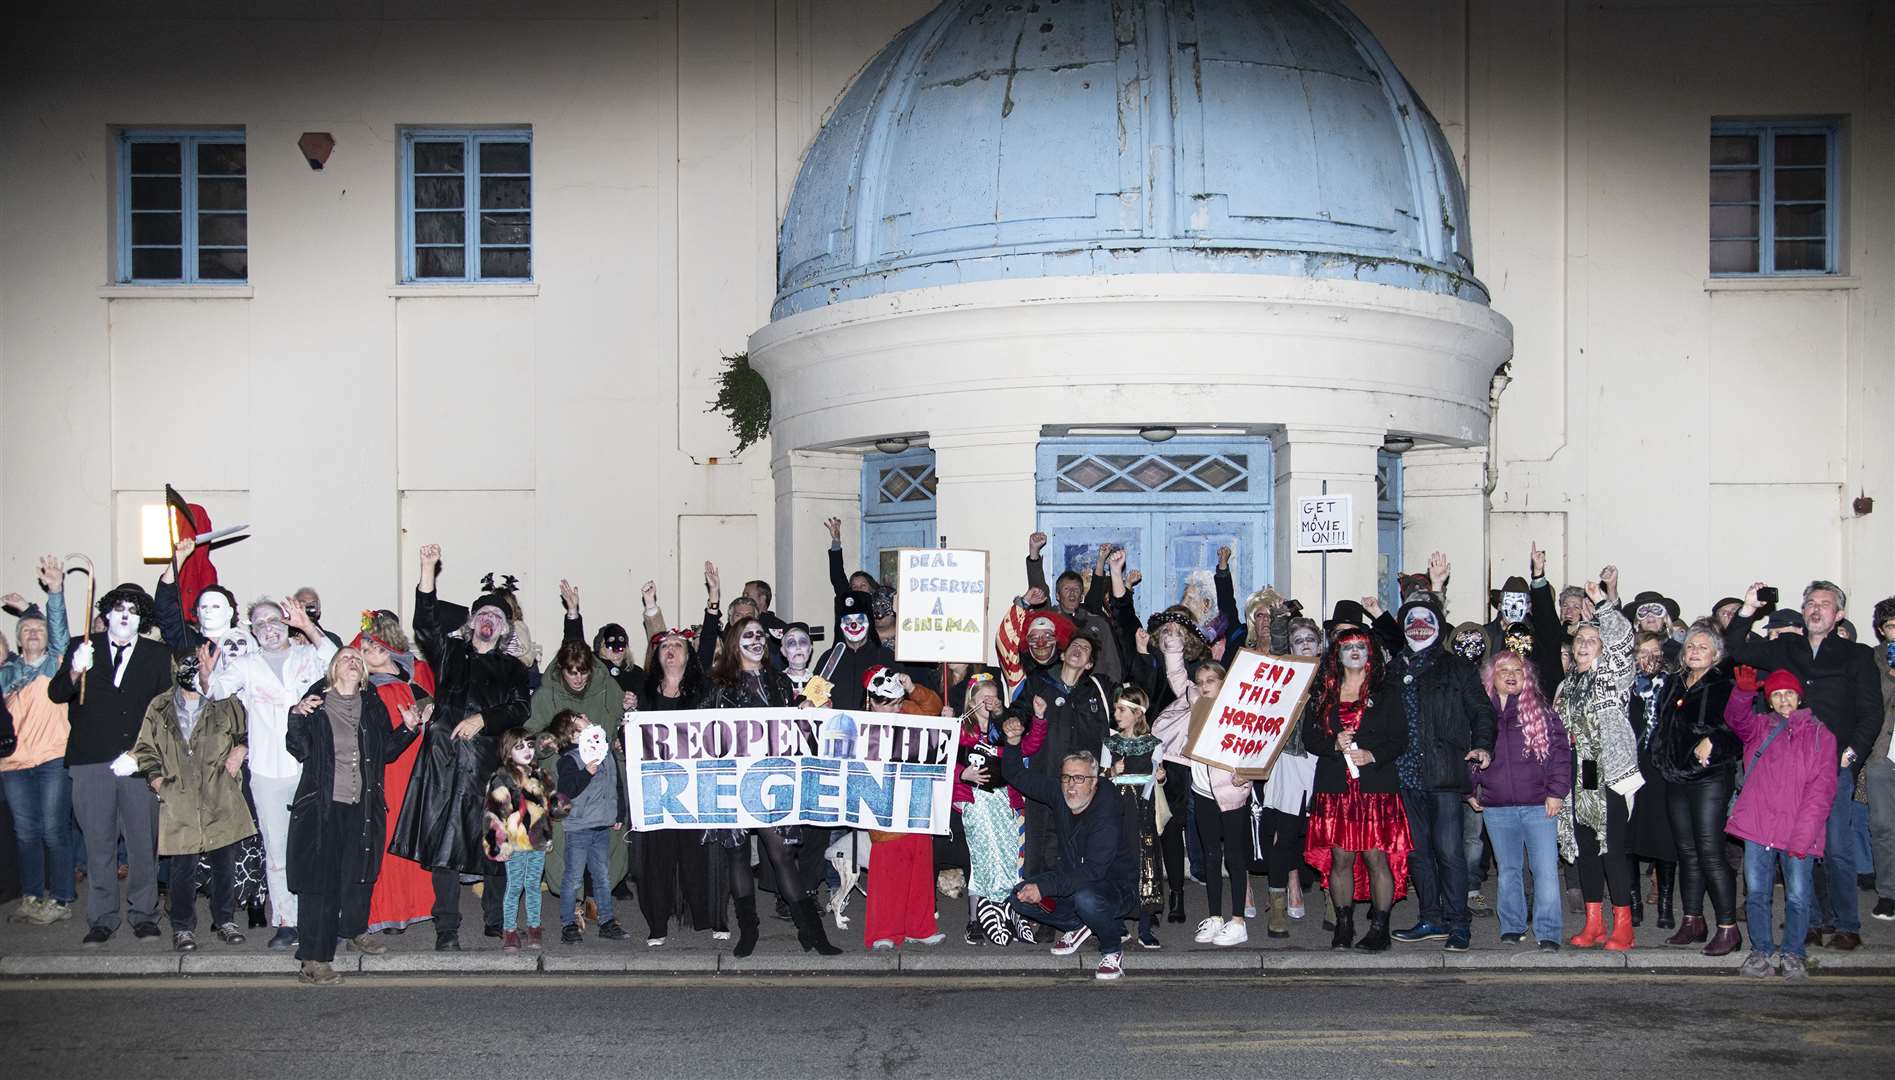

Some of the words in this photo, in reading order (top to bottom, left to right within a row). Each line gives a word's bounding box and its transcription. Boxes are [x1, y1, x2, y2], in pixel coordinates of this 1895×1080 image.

[1303, 501, 1336, 514] GET
[1312, 513, 1318, 521] A
[1302, 520, 1340, 532] MOVIE
[1312, 531, 1345, 544] ON!!!
[910, 552, 958, 568] DEAL
[909, 577, 984, 593] DESERVES
[931, 596, 944, 615] A
[902, 617, 980, 632] CINEMA
[1253, 662, 1296, 687] END
[1238, 682, 1282, 706] THIS
[1219, 706, 1285, 738] HORROR
[639, 719, 823, 761] REOPEN
[860, 724, 952, 764] THE
[1220, 733, 1268, 757] SHOW
[640, 757, 948, 829] REGENT
